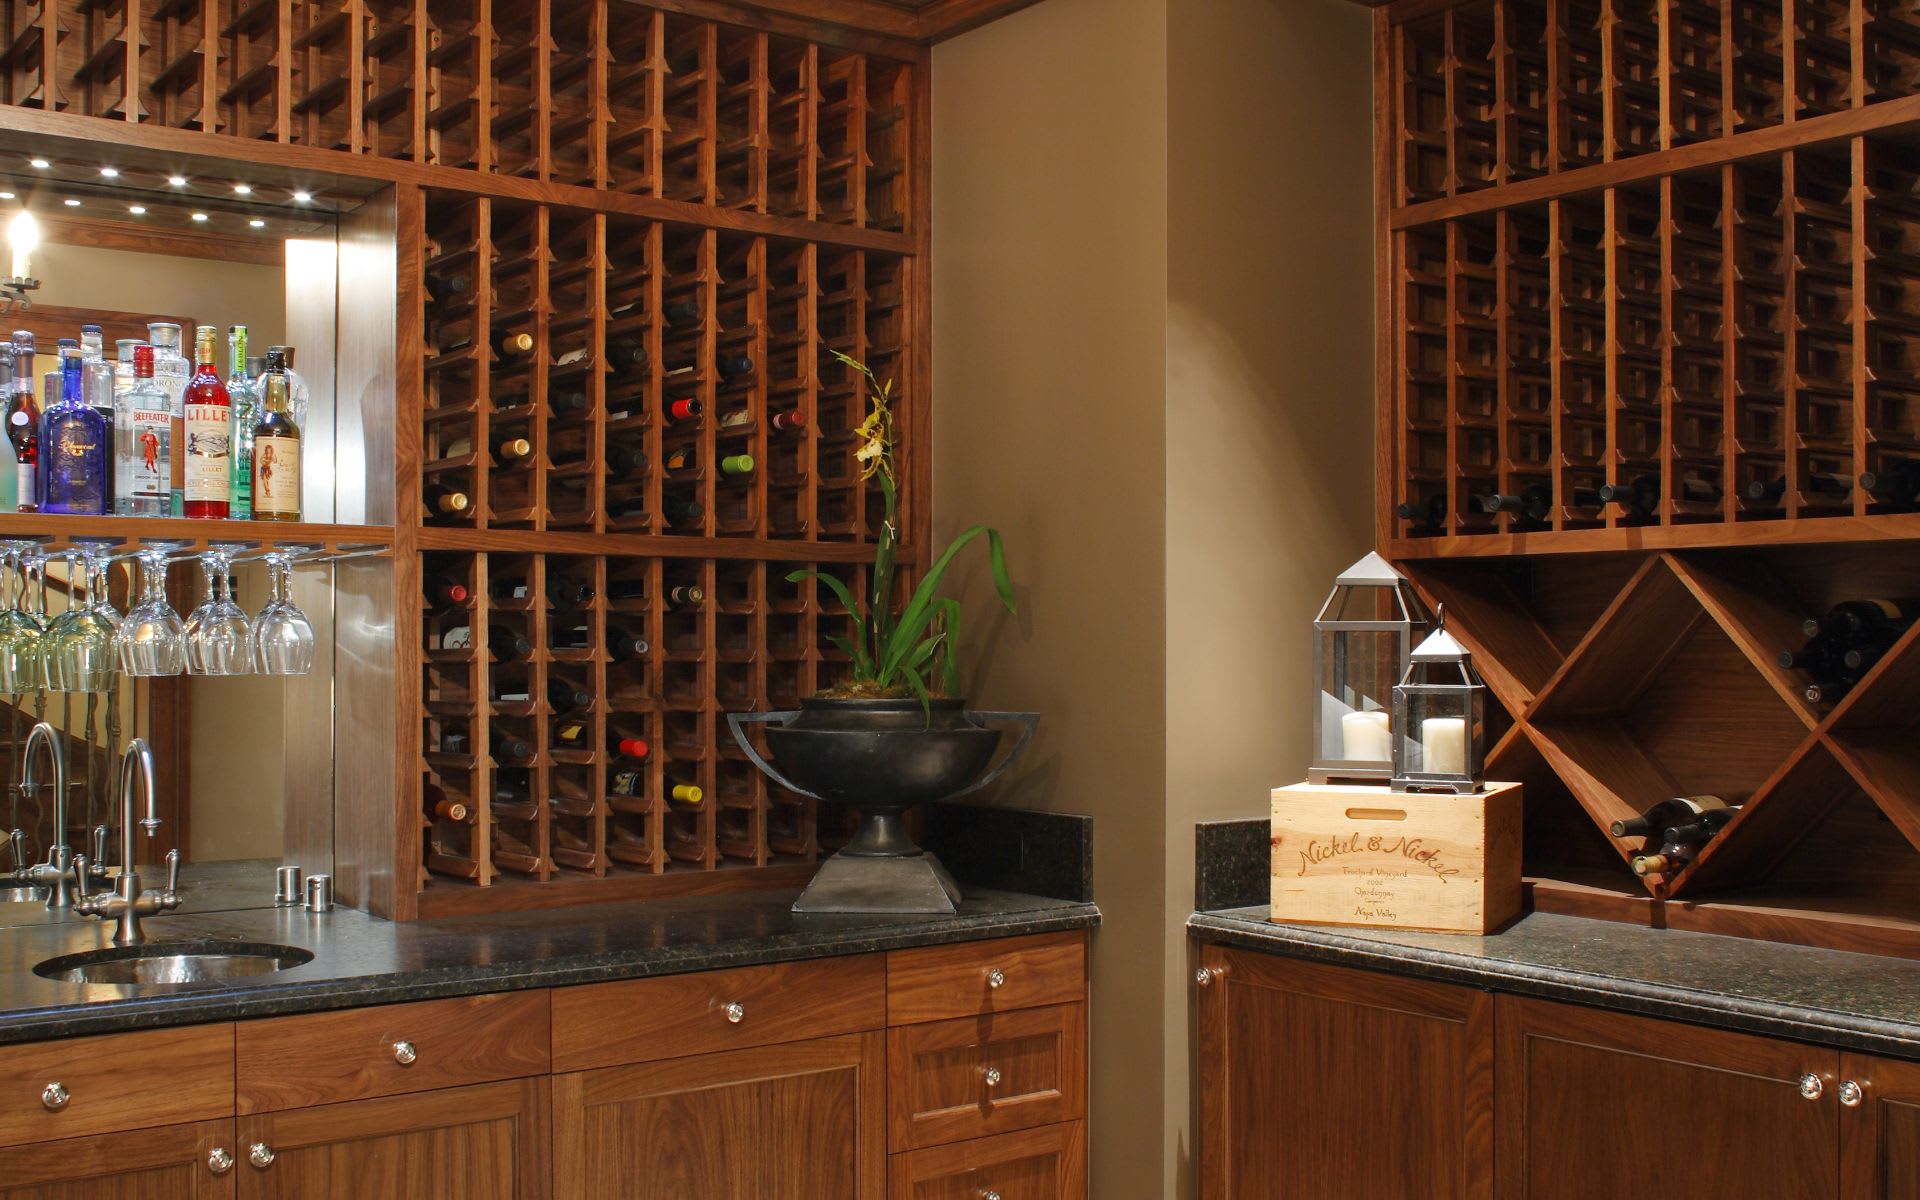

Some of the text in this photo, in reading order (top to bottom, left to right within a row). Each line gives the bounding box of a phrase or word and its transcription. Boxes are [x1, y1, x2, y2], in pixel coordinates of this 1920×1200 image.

[237, 336, 245, 369] LEBLON
[133, 411, 169, 424] BEEFEATER
[188, 408, 230, 423] LILLET
[1298, 832, 1460, 884] Nickel & Nickel
[1375, 867, 1408, 881] Vineyard
[1353, 906, 1397, 922] Napa Valley
